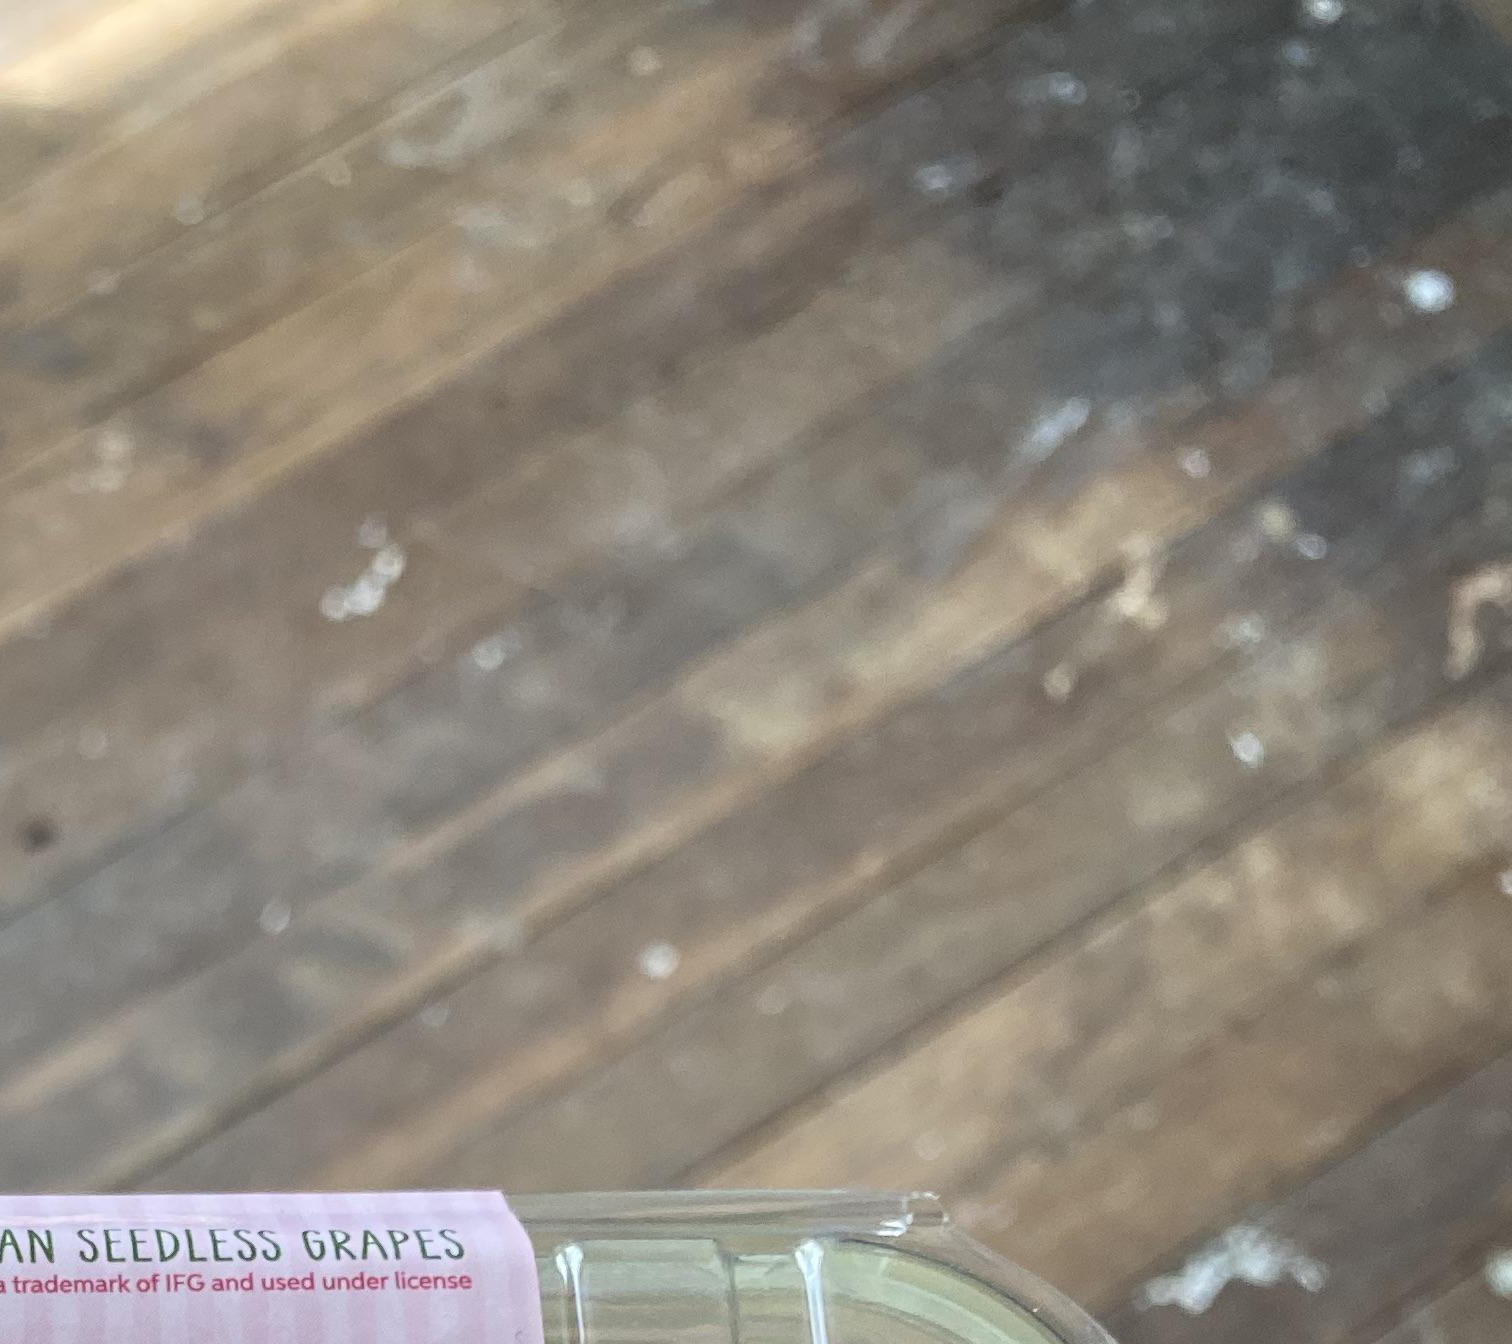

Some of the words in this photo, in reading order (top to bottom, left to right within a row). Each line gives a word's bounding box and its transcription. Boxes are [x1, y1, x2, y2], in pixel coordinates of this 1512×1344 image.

[76, 1228, 282, 1264] SEEDLESS
[301, 1228, 466, 1262] GRAPES
[13, 1274, 130, 1296] trademark
[137, 1273, 161, 1294] of
[165, 1273, 205, 1293] IFG
[211, 1272, 254, 1292] and
[260, 1272, 316, 1292] used
[322, 1271, 389, 1291] under
[395, 1270, 473, 1291] license
